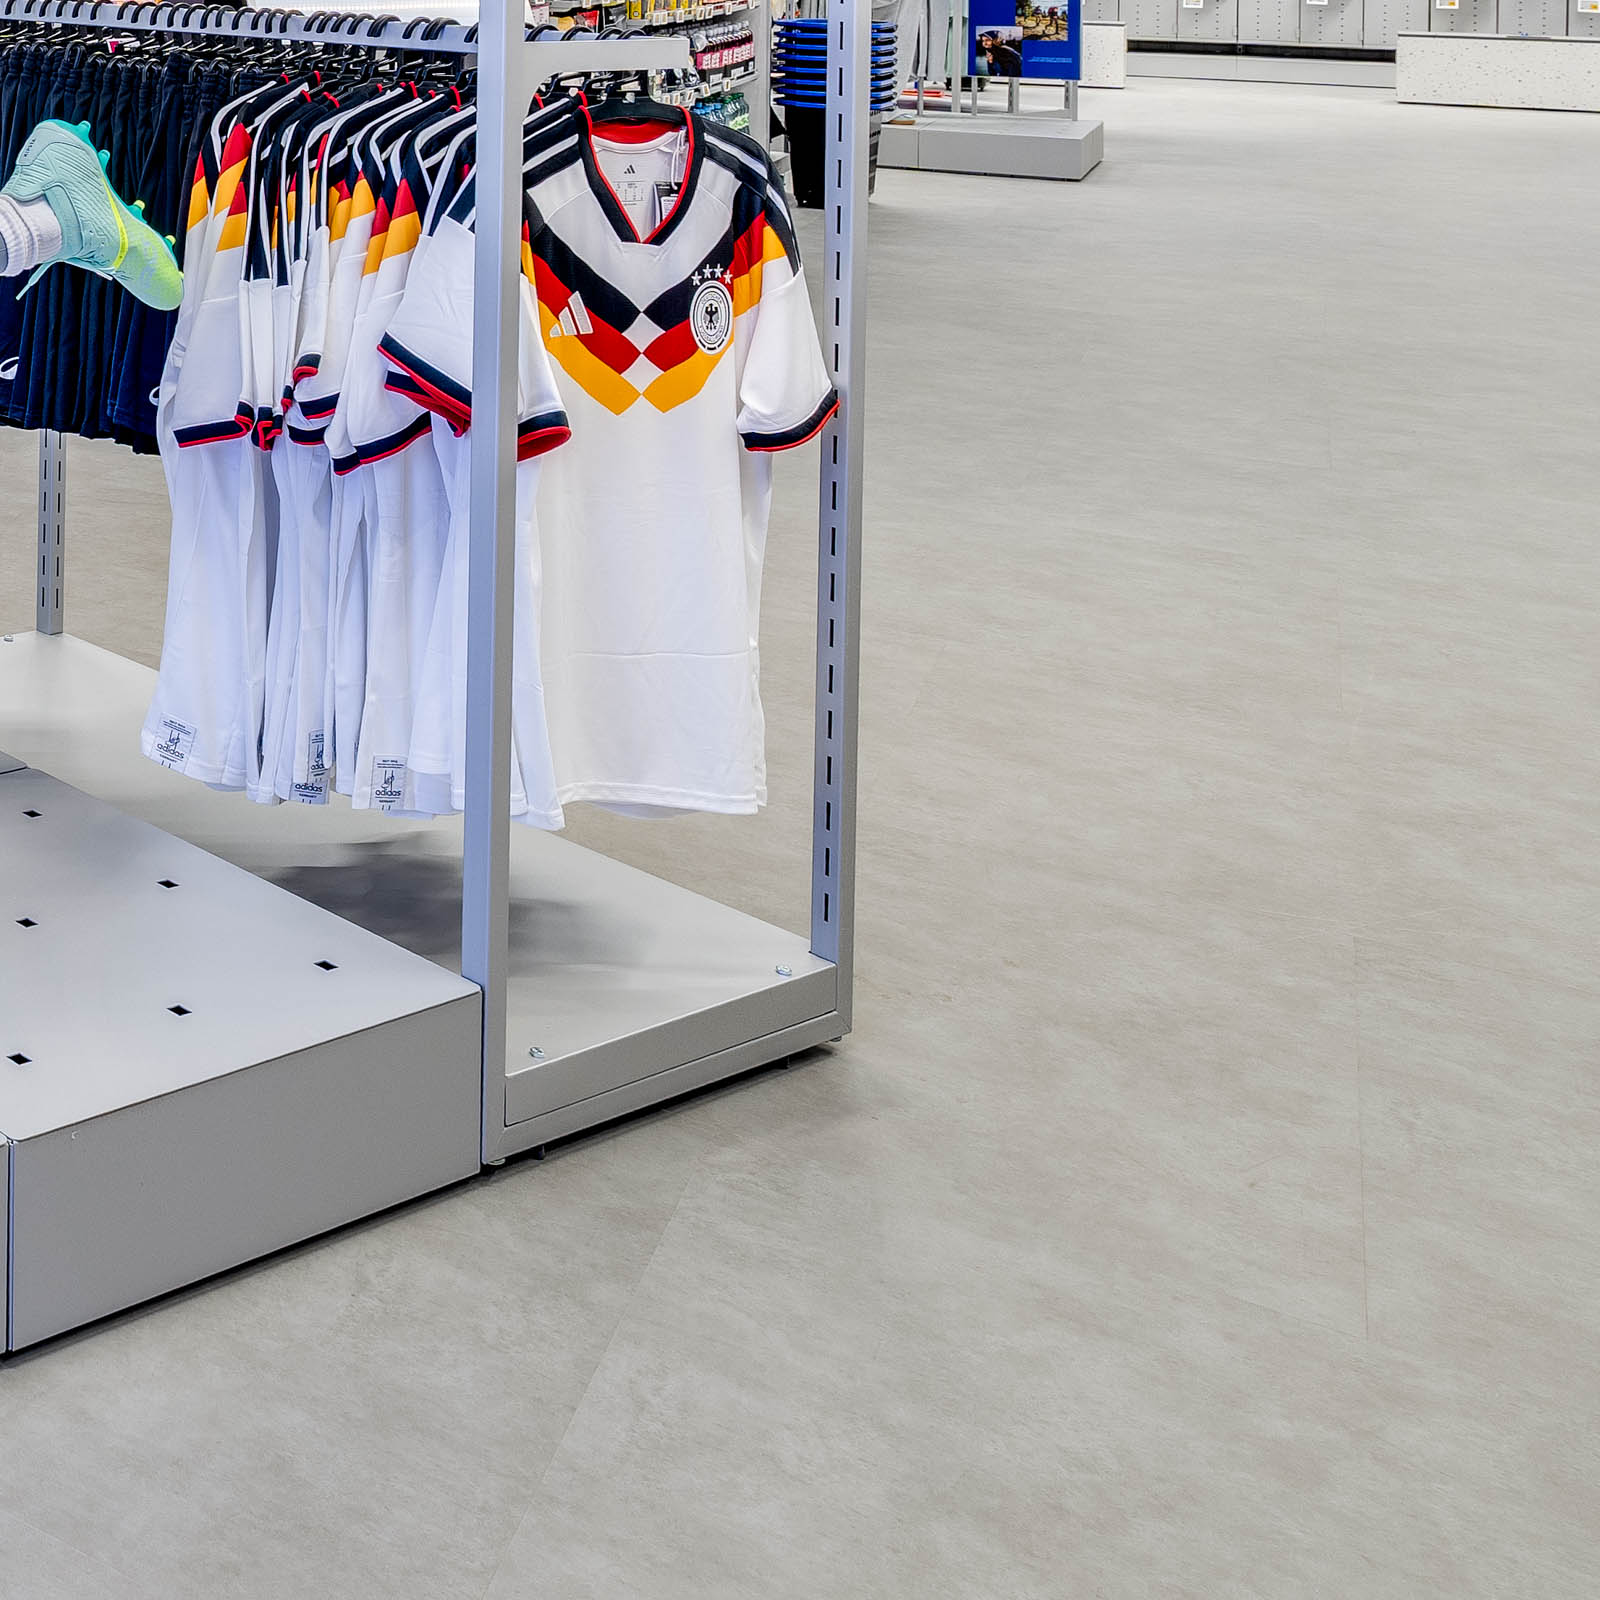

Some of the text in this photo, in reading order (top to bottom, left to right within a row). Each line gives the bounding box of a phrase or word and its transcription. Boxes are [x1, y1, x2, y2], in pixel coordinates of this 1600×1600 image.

[157, 743, 185, 759] adidas
[295, 783, 323, 793] adidas
[375, 789, 402, 797] adidas
